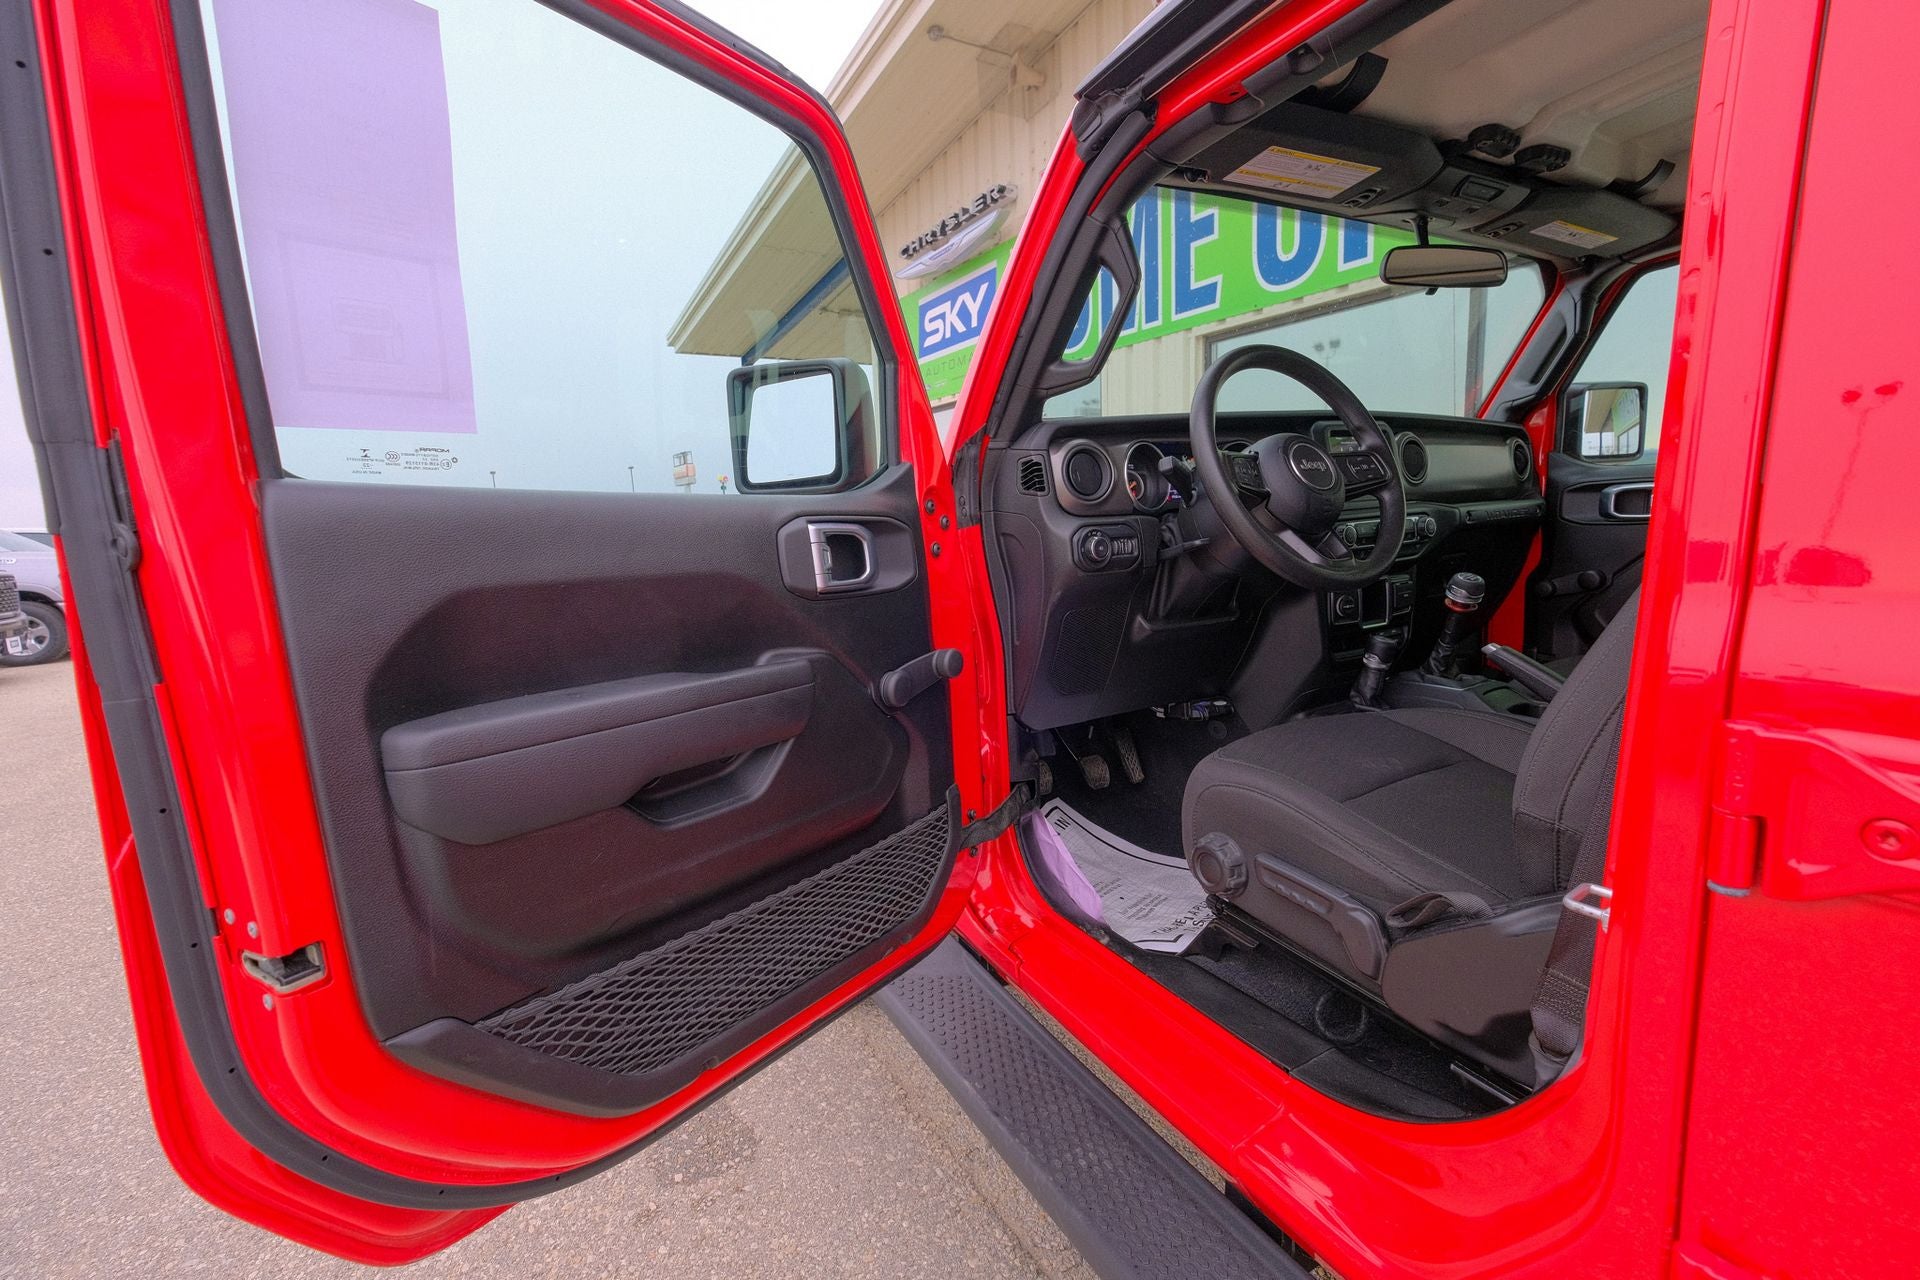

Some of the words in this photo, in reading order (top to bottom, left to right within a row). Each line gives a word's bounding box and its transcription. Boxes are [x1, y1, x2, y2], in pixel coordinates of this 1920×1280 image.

[901, 184, 1007, 260] CHRYSLER
[923, 282, 989, 348] SKY
[1299, 458, 1327, 472] Jeep
